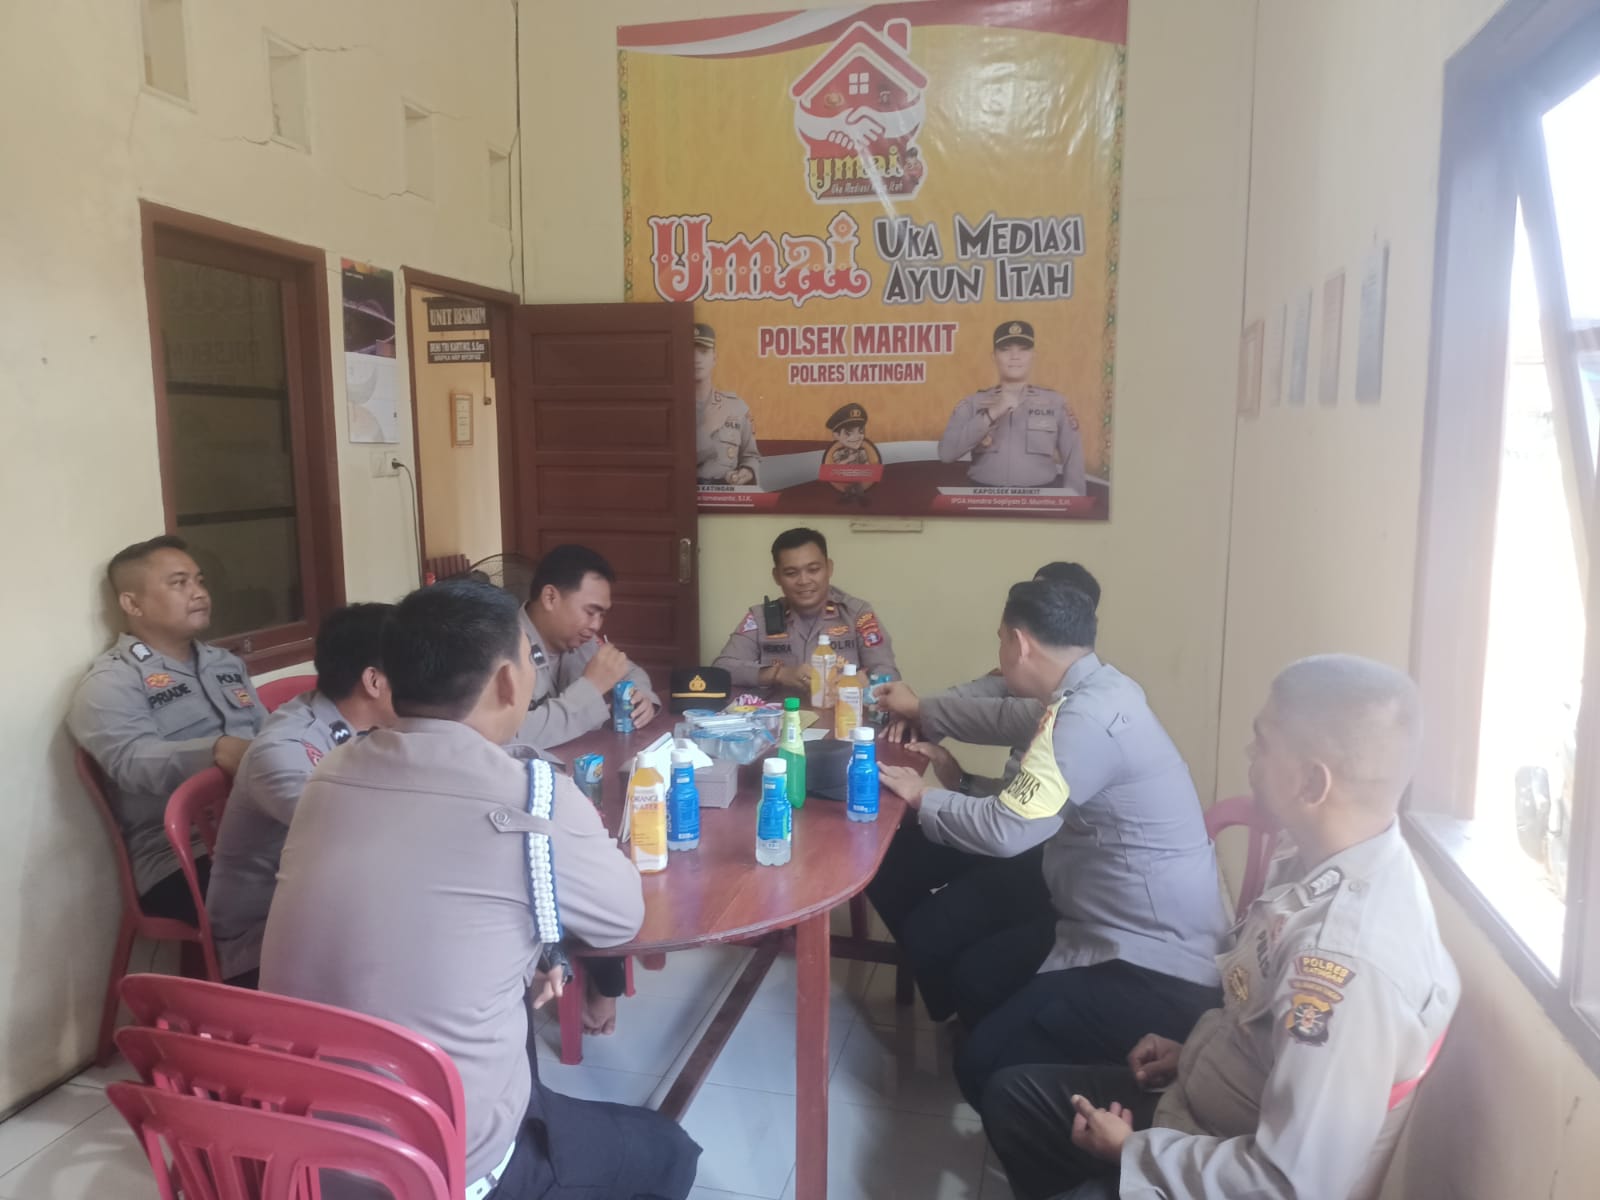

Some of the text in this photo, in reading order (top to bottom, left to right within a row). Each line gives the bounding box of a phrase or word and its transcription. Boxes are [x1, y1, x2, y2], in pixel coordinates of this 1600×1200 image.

[650, 212, 869, 305] Umai
[430, 309, 451, 325] UNIT
[760, 324, 957, 355] POLSEK MARIKIT
[790, 363, 924, 383] POLRES KATINGAN
[830, 640, 855, 650] OLRI
[1303, 957, 1350, 978] POLRES
